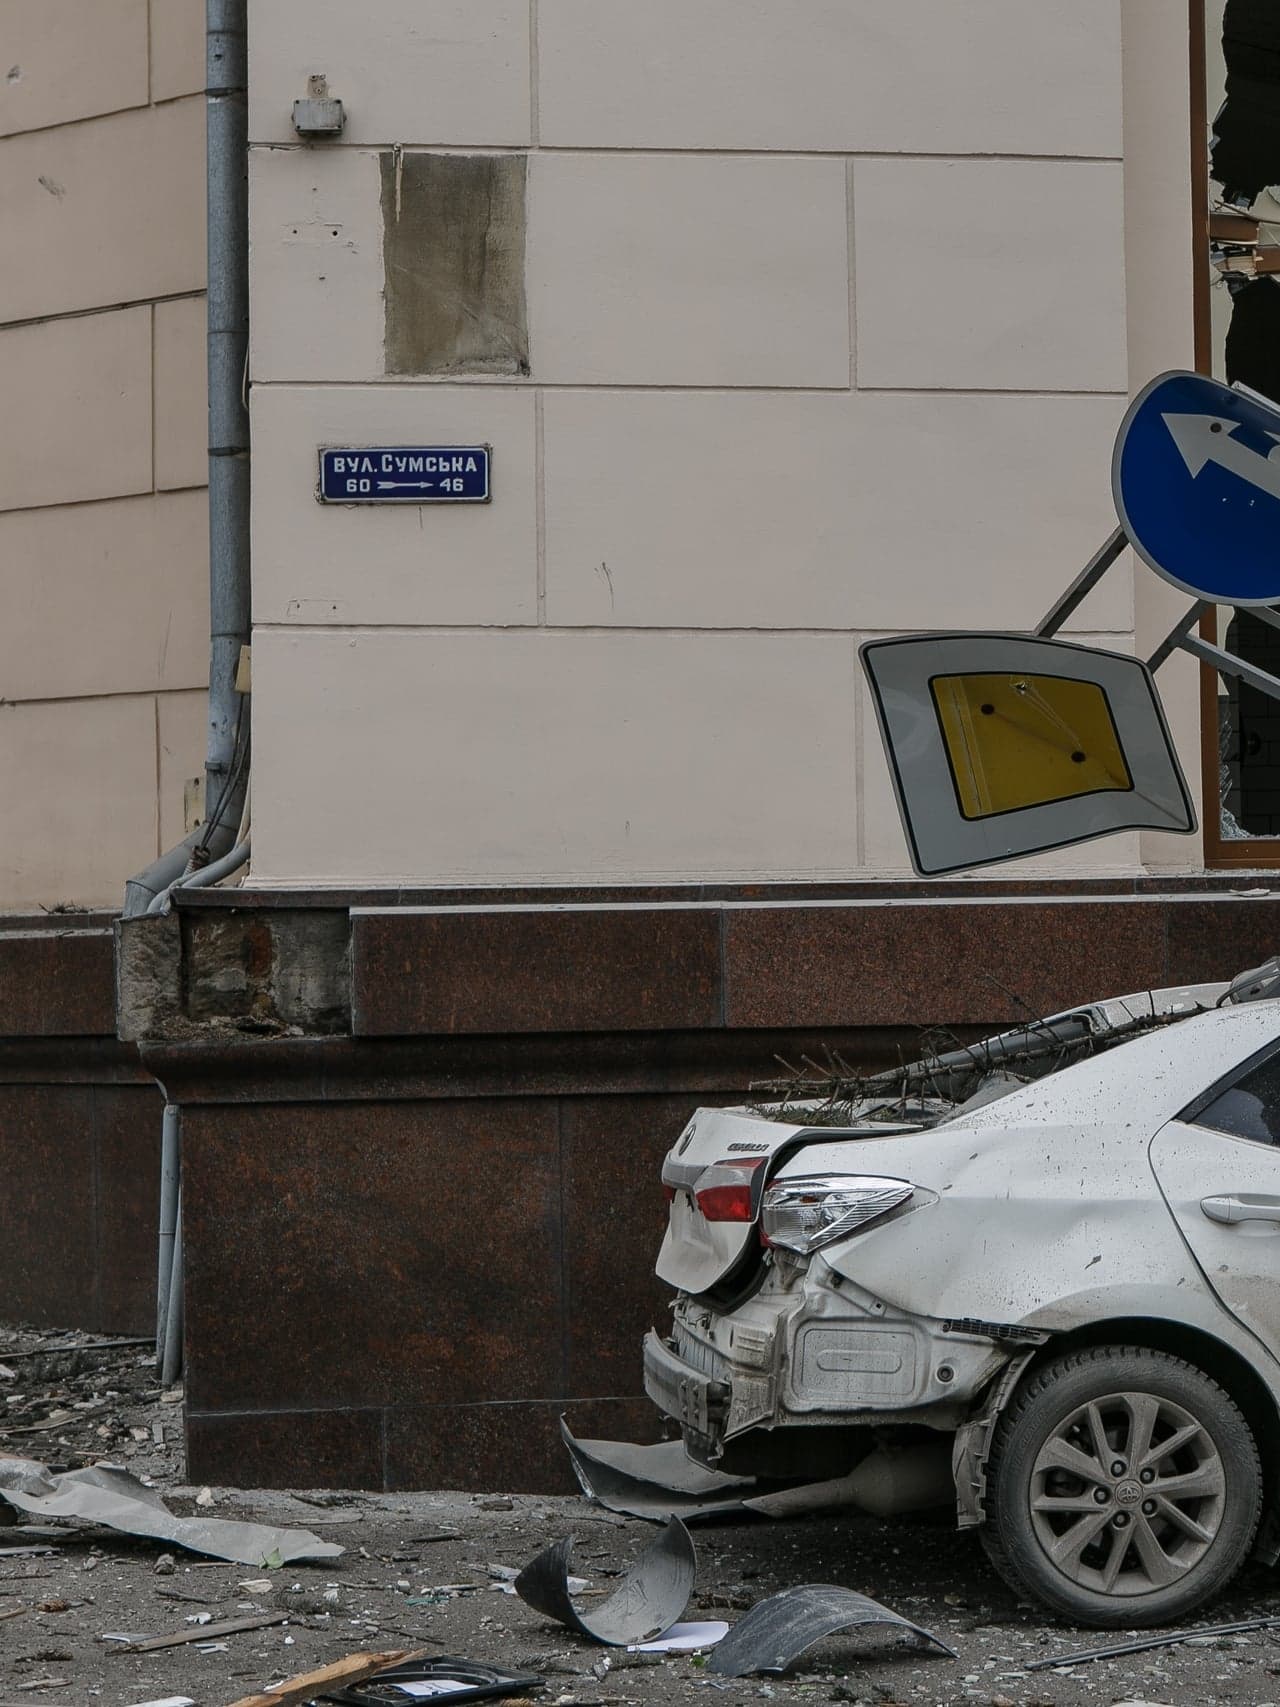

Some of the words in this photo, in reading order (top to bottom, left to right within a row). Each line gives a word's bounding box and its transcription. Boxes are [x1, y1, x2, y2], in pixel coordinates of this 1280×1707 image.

[381, 454, 478, 473] СУМСЬКА
[346, 479, 371, 492] 60
[439, 478, 464, 492] 46
